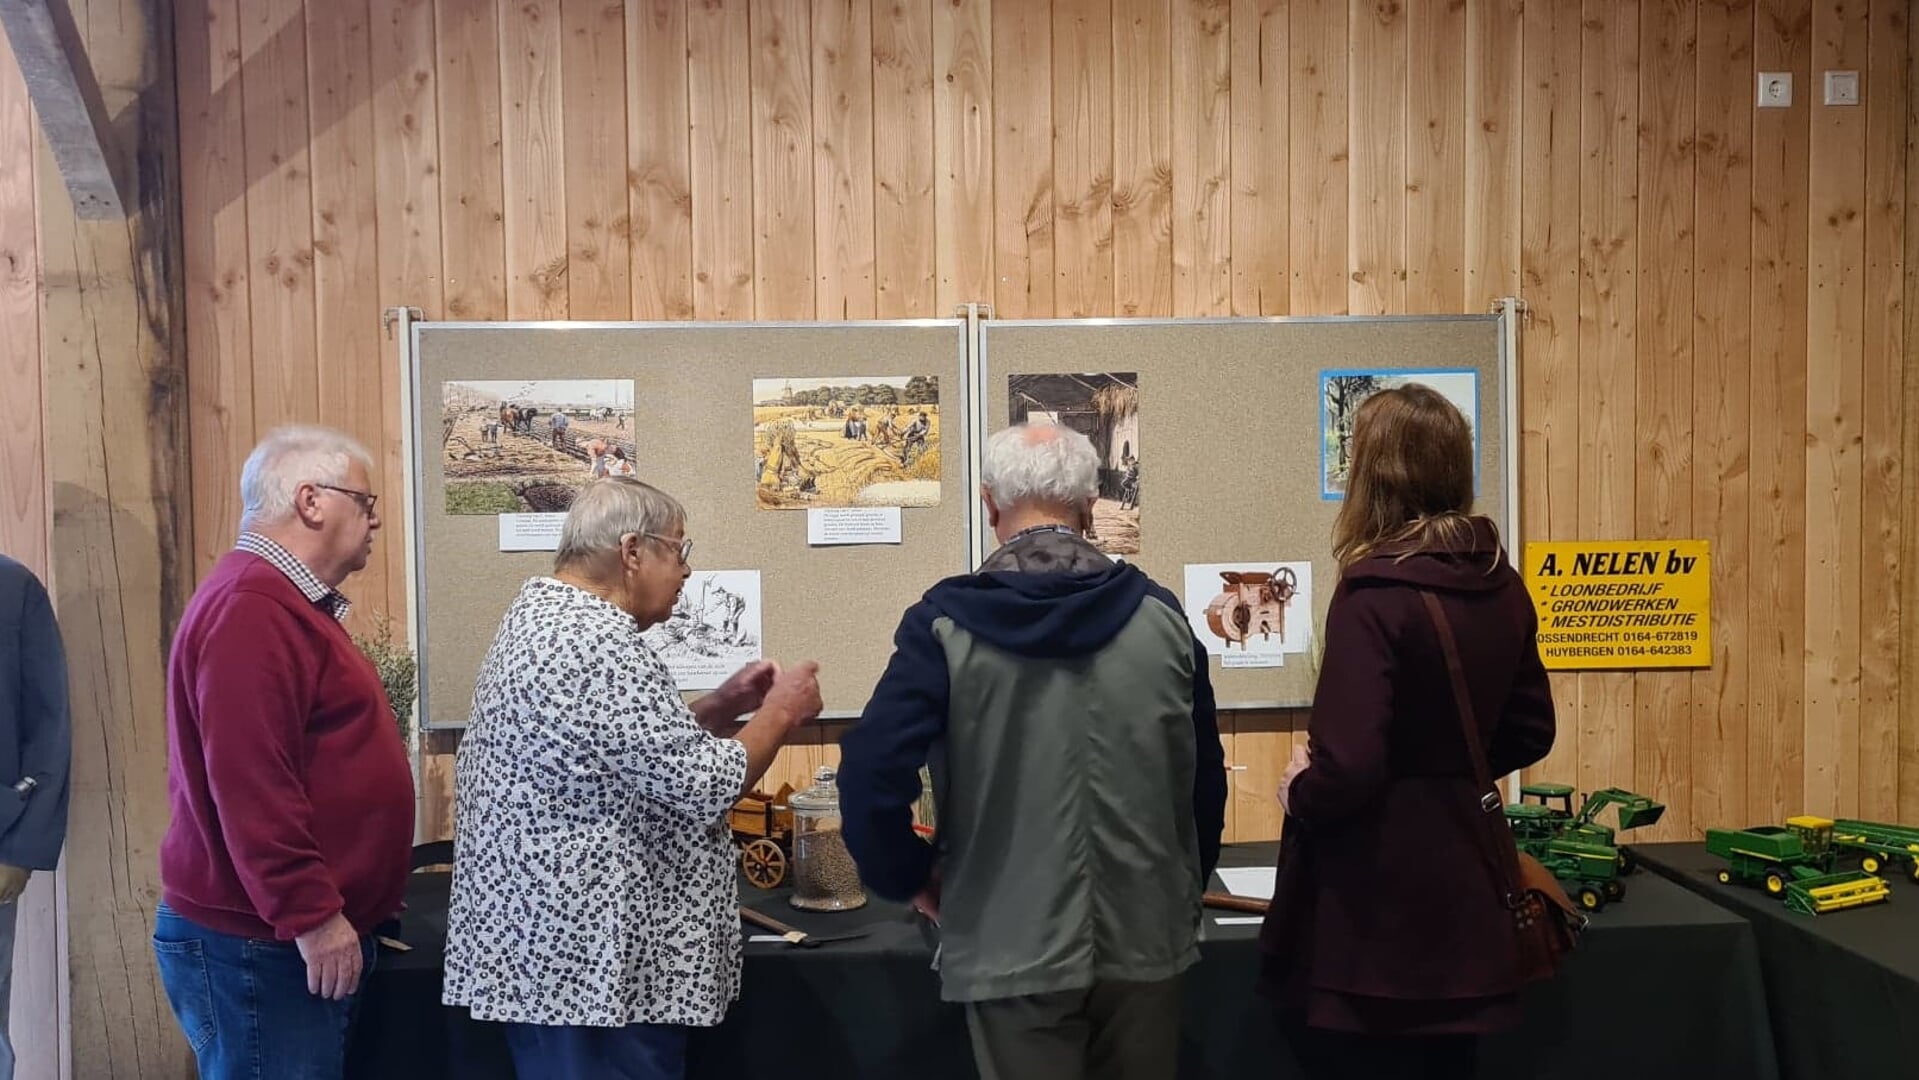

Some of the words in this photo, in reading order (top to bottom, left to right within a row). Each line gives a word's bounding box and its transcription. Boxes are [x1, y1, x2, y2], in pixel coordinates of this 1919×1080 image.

[1538, 553, 1563, 576] A.
[1572, 552, 1660, 576] NELEN
[1665, 548, 1697, 574] bv
[1550, 583, 1664, 597] LOONBEDRIJF
[1551, 598, 1679, 612] GRONDWERKEN
[1551, 613, 1698, 627] MESTDISTRIBUTIE
[1536, 632, 1620, 643] OSSENDRECHT
[1623, 631, 1698, 641] 0164-672819
[1546, 647, 1614, 657] HUYBERGEN
[1617, 645, 1692, 655] 0164-642383
